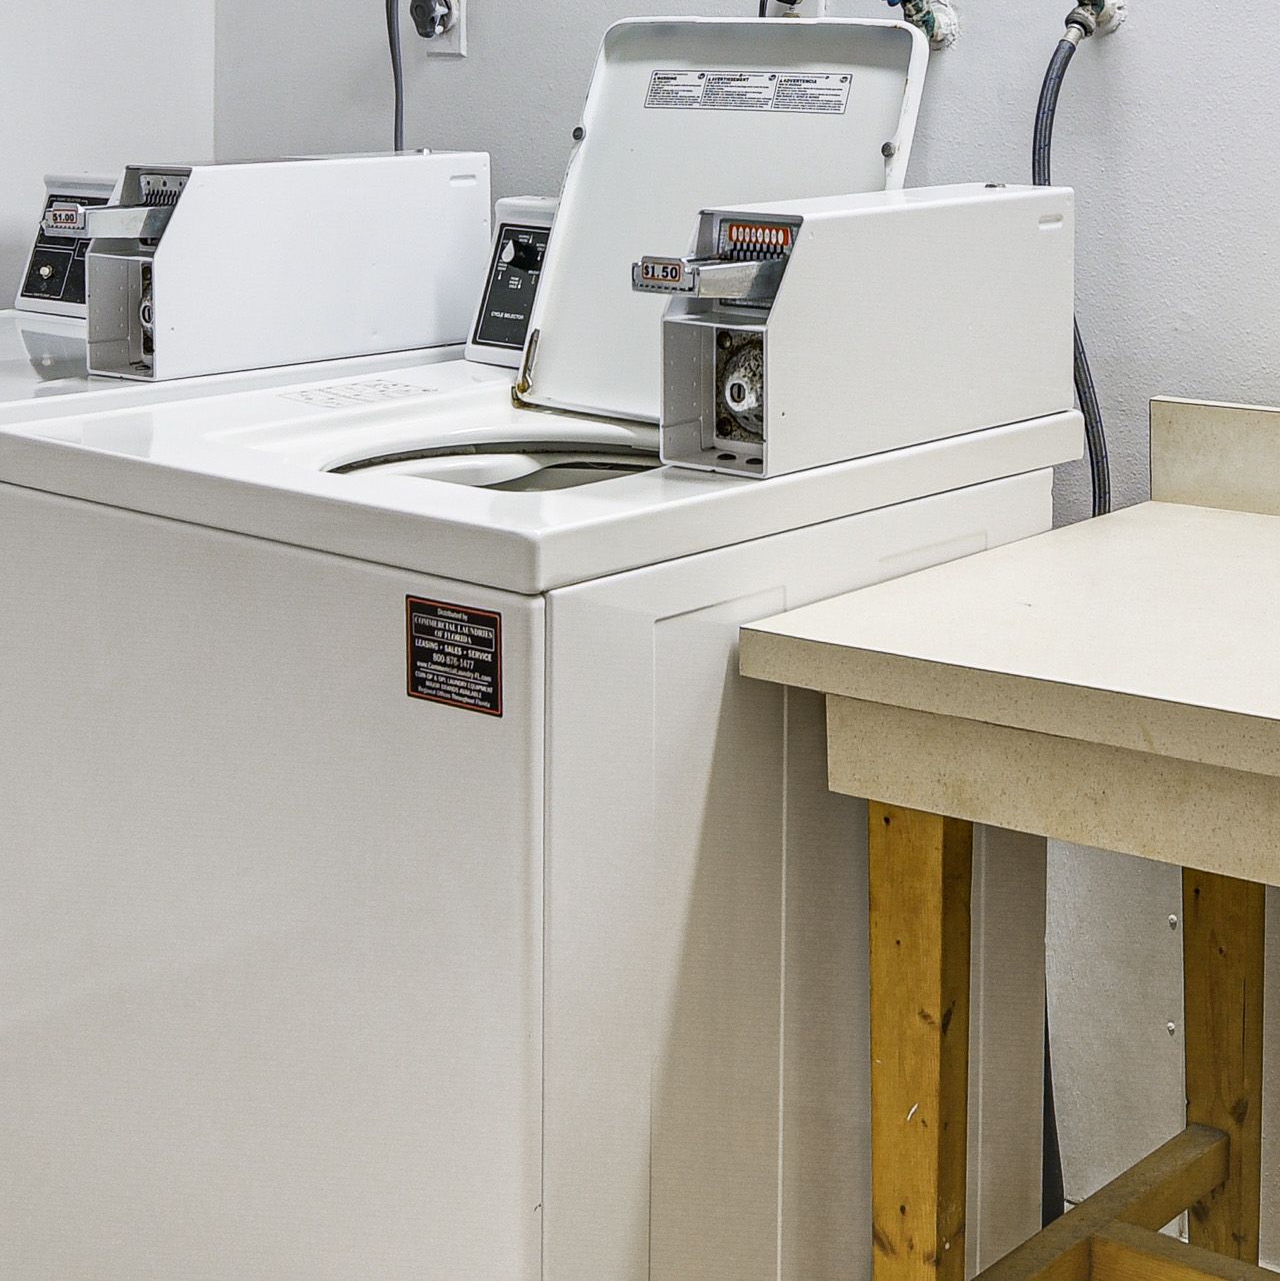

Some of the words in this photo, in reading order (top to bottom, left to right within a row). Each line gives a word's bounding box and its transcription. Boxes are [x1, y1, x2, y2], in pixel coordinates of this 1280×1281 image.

[644, 265, 678, 280] $1.50
[415, 616, 456, 631] COMMERCIAL
[458, 625, 492, 638] LAUNDRIES
[444, 632, 472, 644] FLORIDA
[415, 639, 438, 650] LEASING
[445, 644, 462, 655] SALES
[468, 650, 492, 662] SERVICE
[433, 653, 474, 669] 800-876-1477
